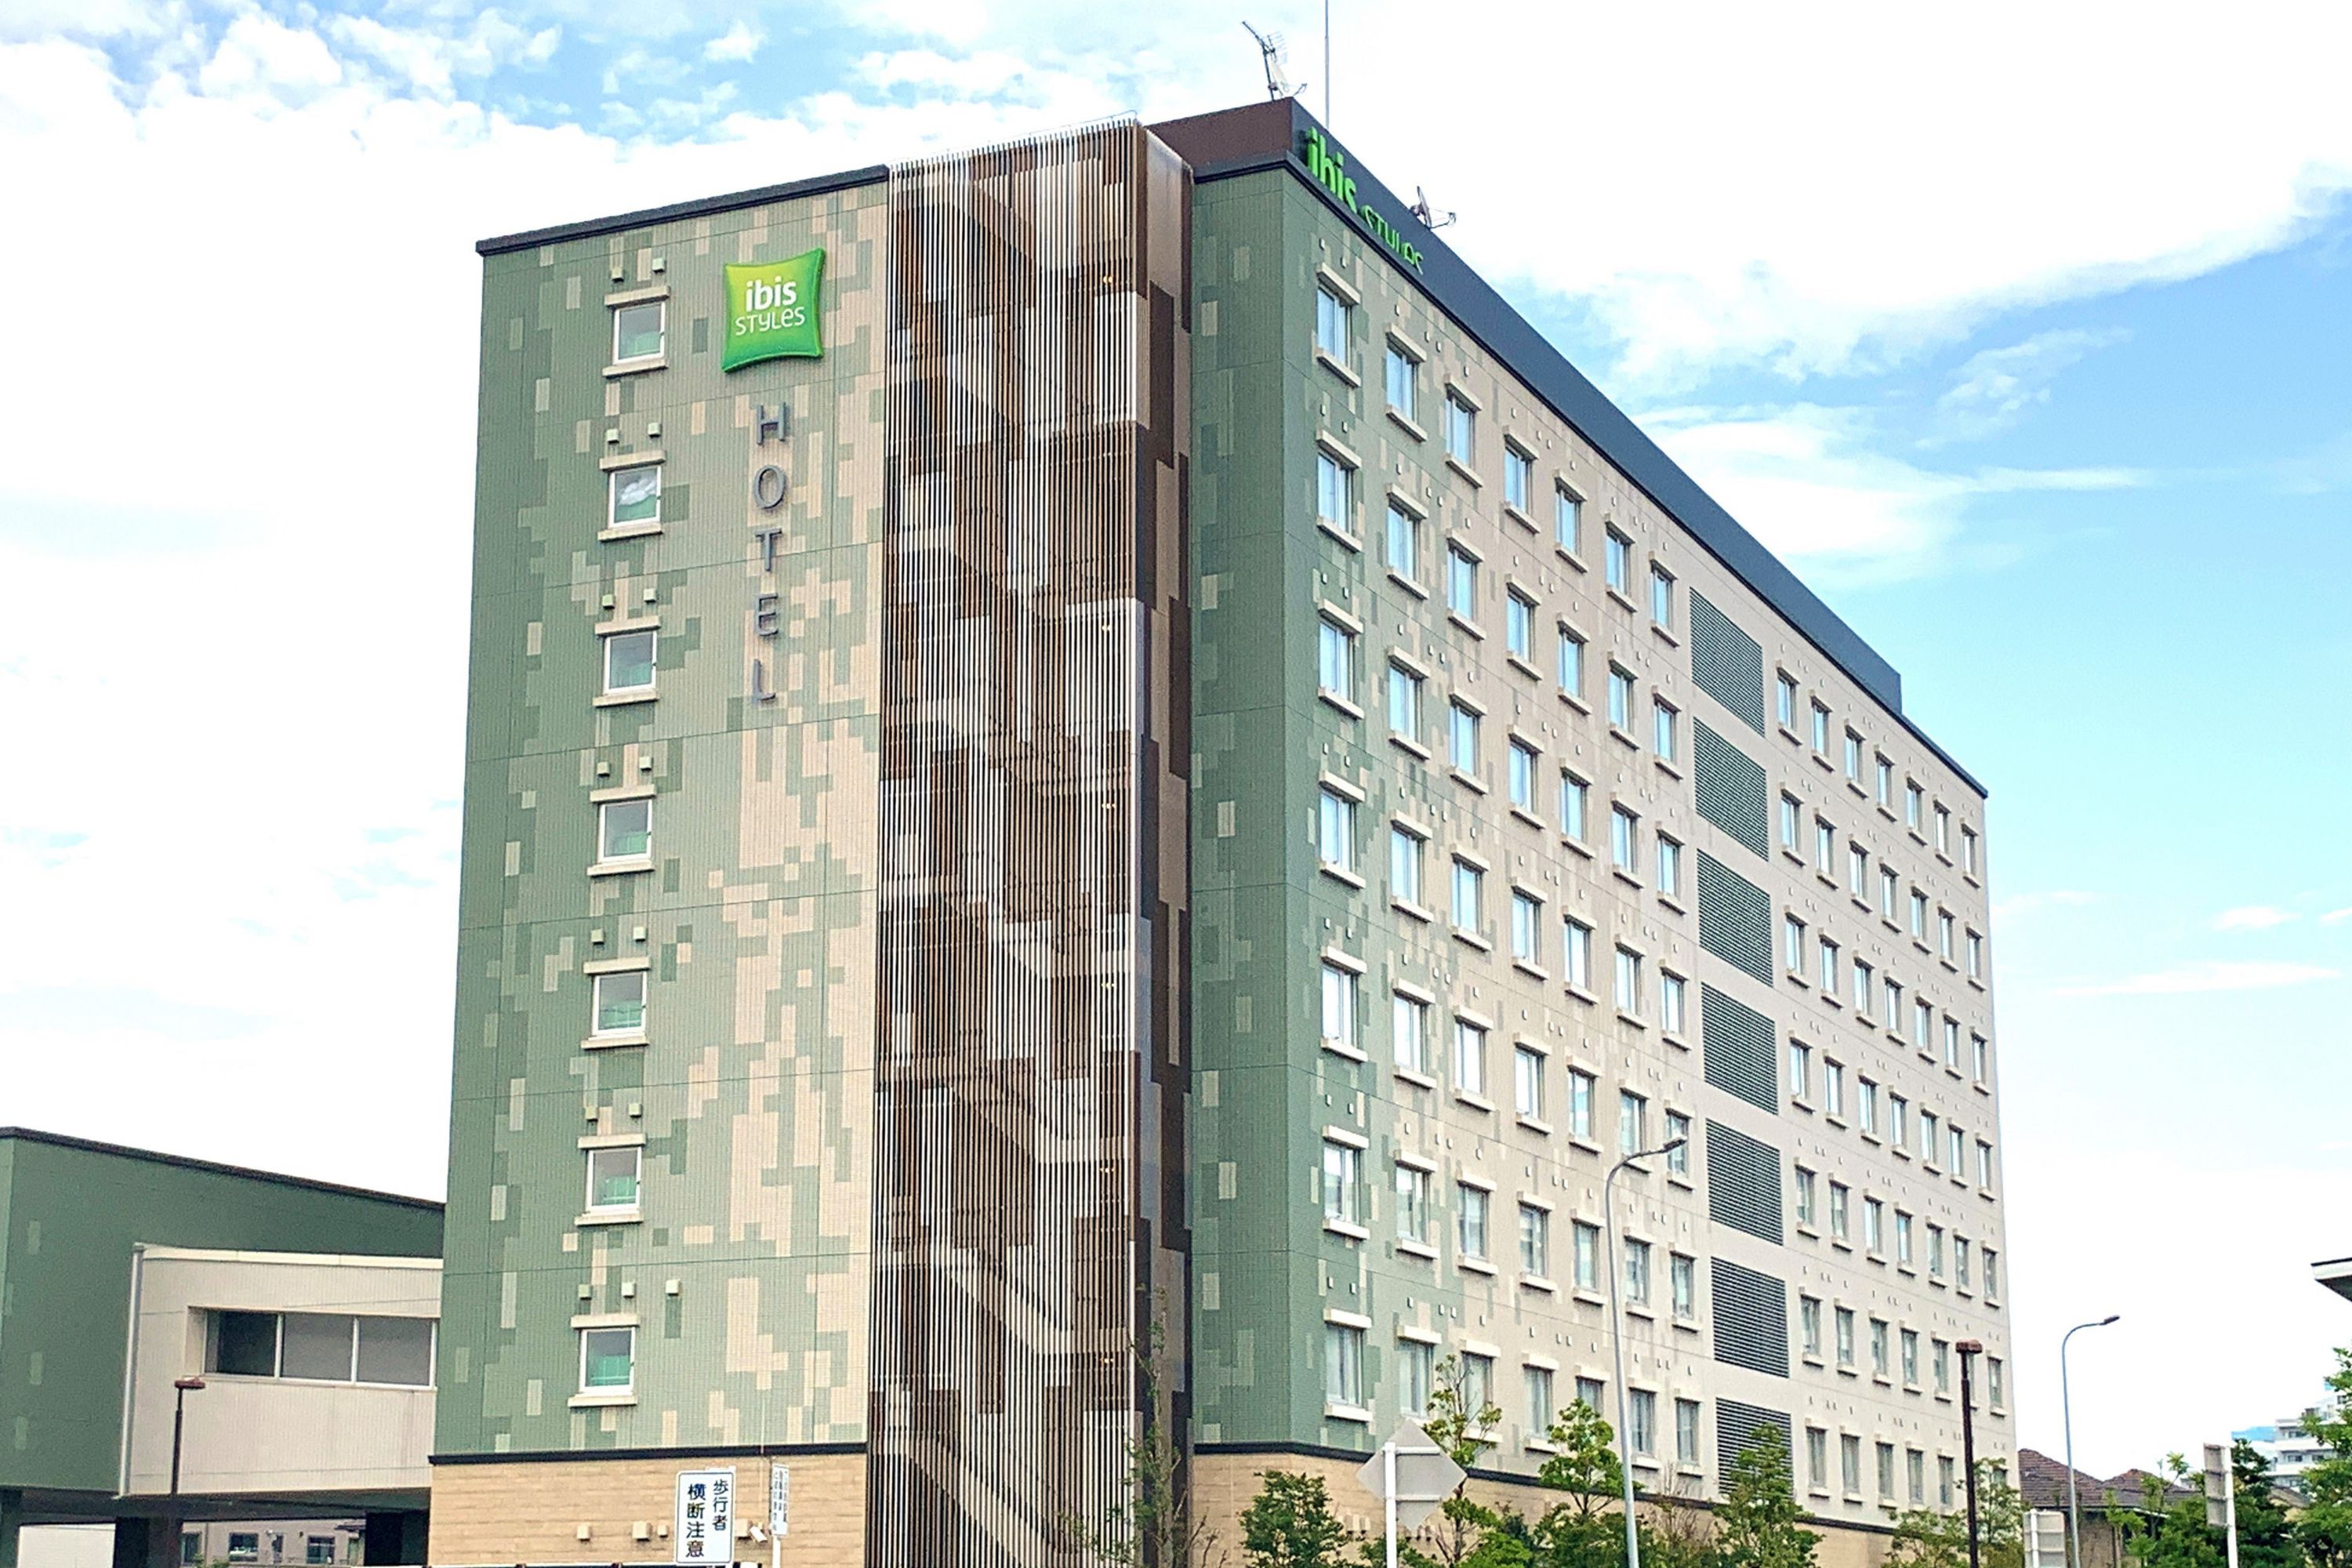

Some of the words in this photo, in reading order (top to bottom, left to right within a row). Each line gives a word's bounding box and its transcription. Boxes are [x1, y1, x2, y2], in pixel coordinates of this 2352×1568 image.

[746, 276, 797, 312] ibis
[753, 401, 788, 705] HOTEL
[685, 1483, 706, 1558] 横断注意
[712, 1479, 729, 1531] 歩行者
